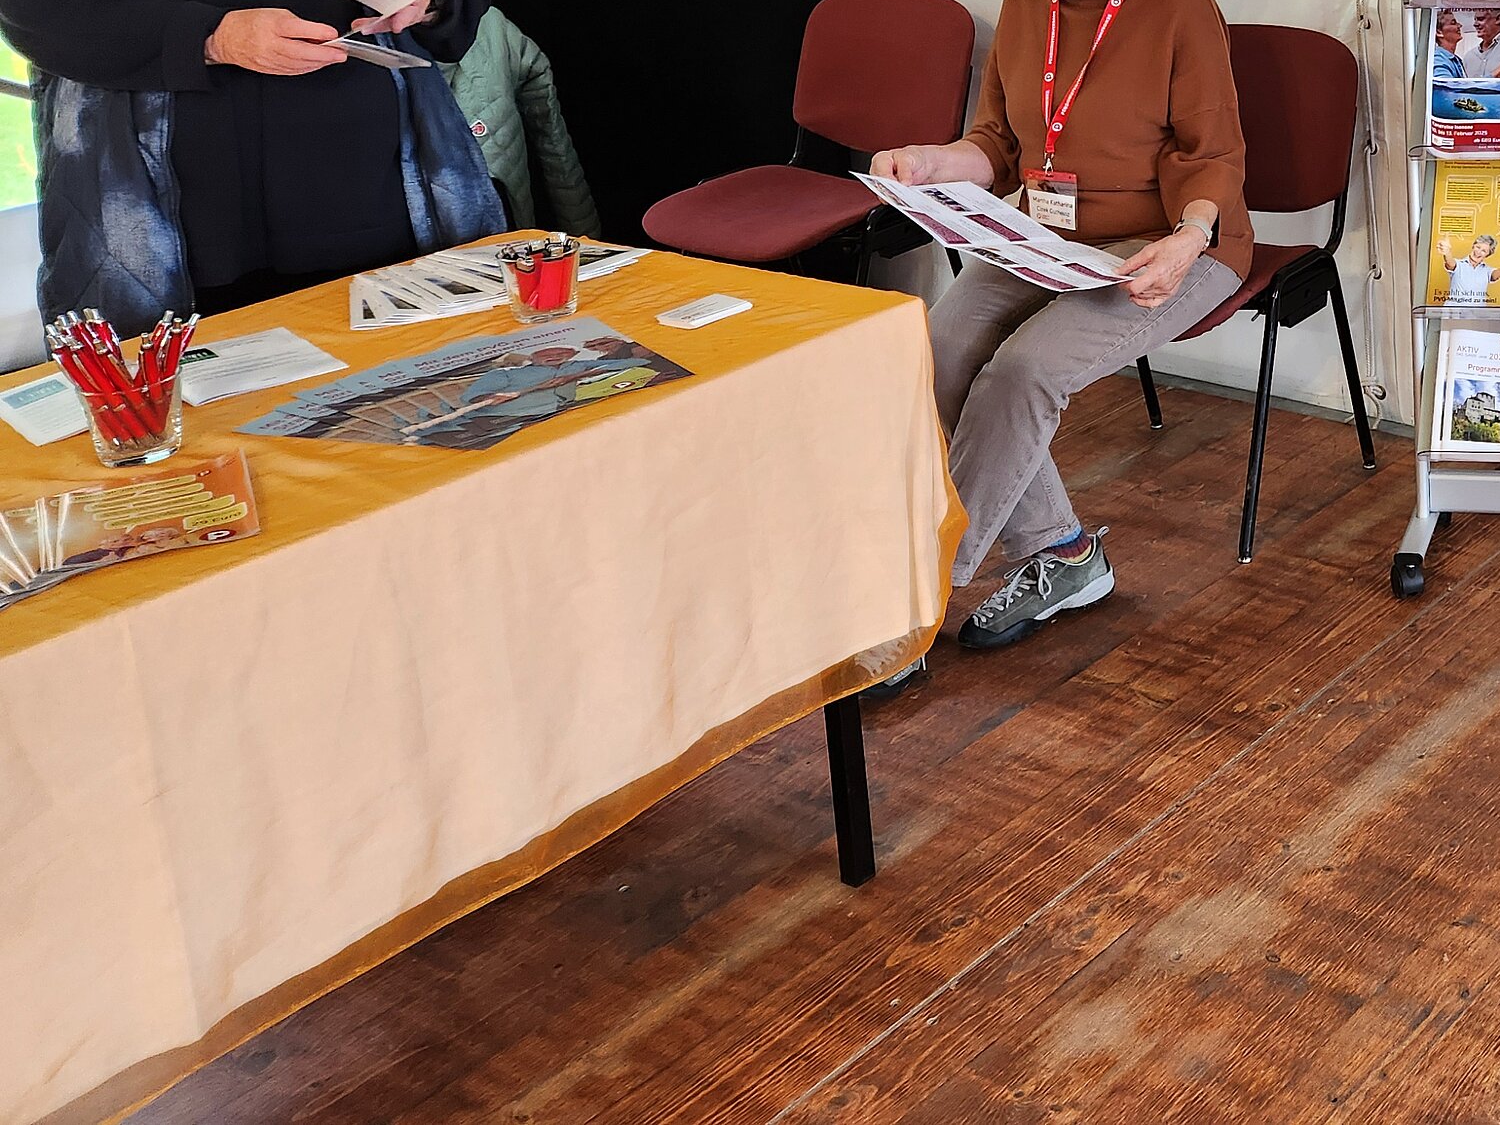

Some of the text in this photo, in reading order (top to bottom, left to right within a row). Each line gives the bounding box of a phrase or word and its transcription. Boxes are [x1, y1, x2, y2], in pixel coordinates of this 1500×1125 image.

[1434, 288, 1442, 296] Es
[1443, 288, 1461, 297] zahlt
[1461, 288, 1475, 297] sich
[1433, 296, 1472, 304] PVÖ-Mitglied
[1456, 345, 1480, 354] AKTIV
